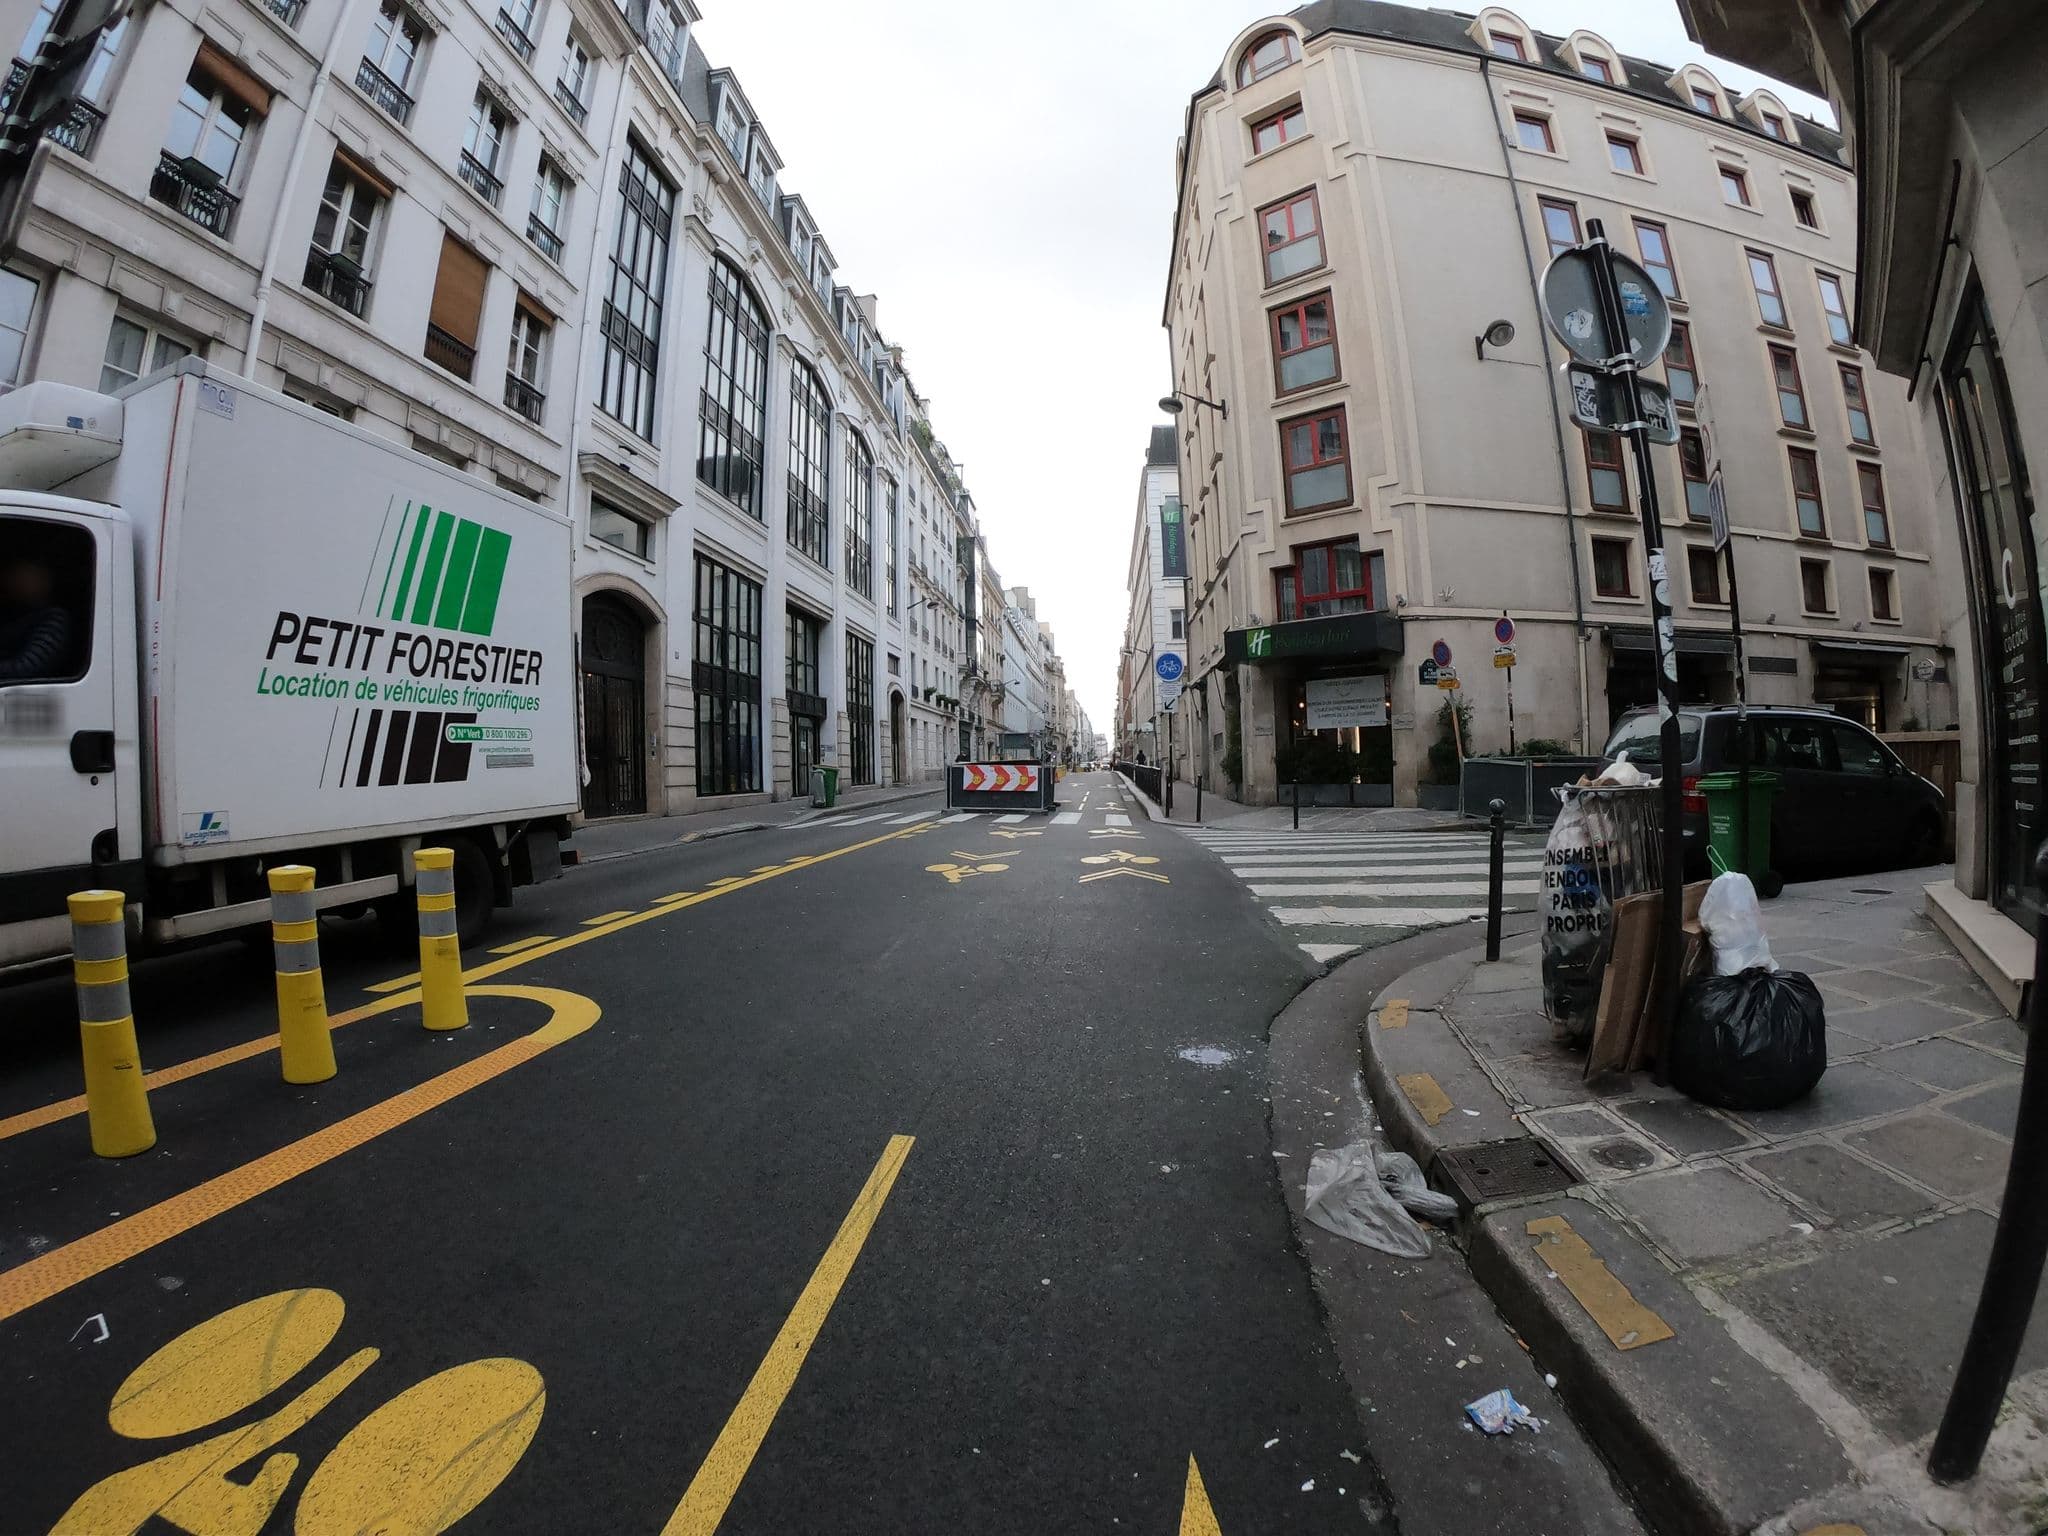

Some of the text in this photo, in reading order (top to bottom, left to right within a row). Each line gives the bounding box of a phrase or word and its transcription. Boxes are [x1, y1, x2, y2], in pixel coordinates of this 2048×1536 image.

[265, 611, 543, 685] PETIT FORESTIER
[257, 667, 541, 713] Location de véhicules frigorifiques
[485, 729, 491, 738] 0
[490, 730, 504, 738] 800
[504, 730, 516, 738] 100
